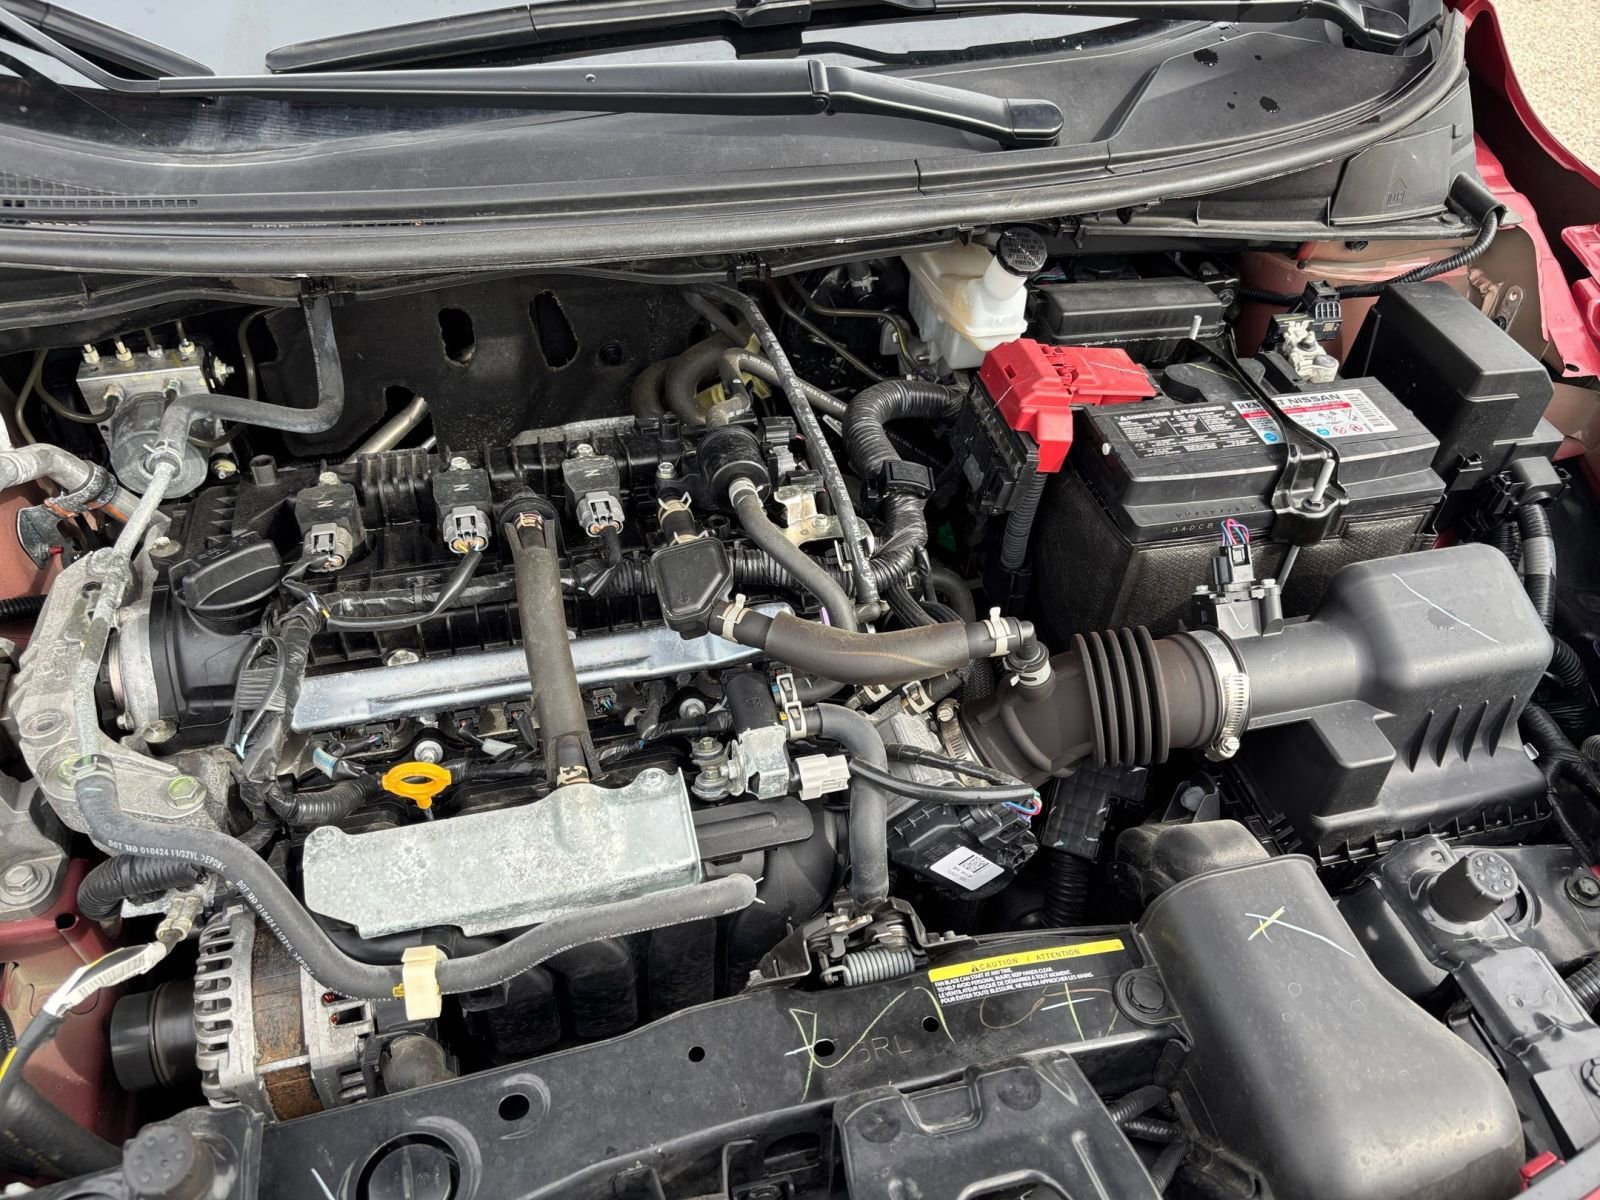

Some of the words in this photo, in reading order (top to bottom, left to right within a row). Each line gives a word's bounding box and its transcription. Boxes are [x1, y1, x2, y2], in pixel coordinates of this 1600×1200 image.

[1289, 393, 1341, 404] NISSAN
[141, 847, 169, 857] 010424
[980, 957, 1018, 970] CAUTION
[1037, 948, 1081, 961] ATTENTION
[970, 972, 984, 980] START
[971, 977, 995, 986] PERSONAL
[940, 997, 956, 1005] POUR
[973, 989, 990, 997] TOUTE
[1041, 976, 1068, 985] APPROCHER
[945, 986, 978, 997] VENTILATEUR
[978, 982, 997, 990] RISQUE
